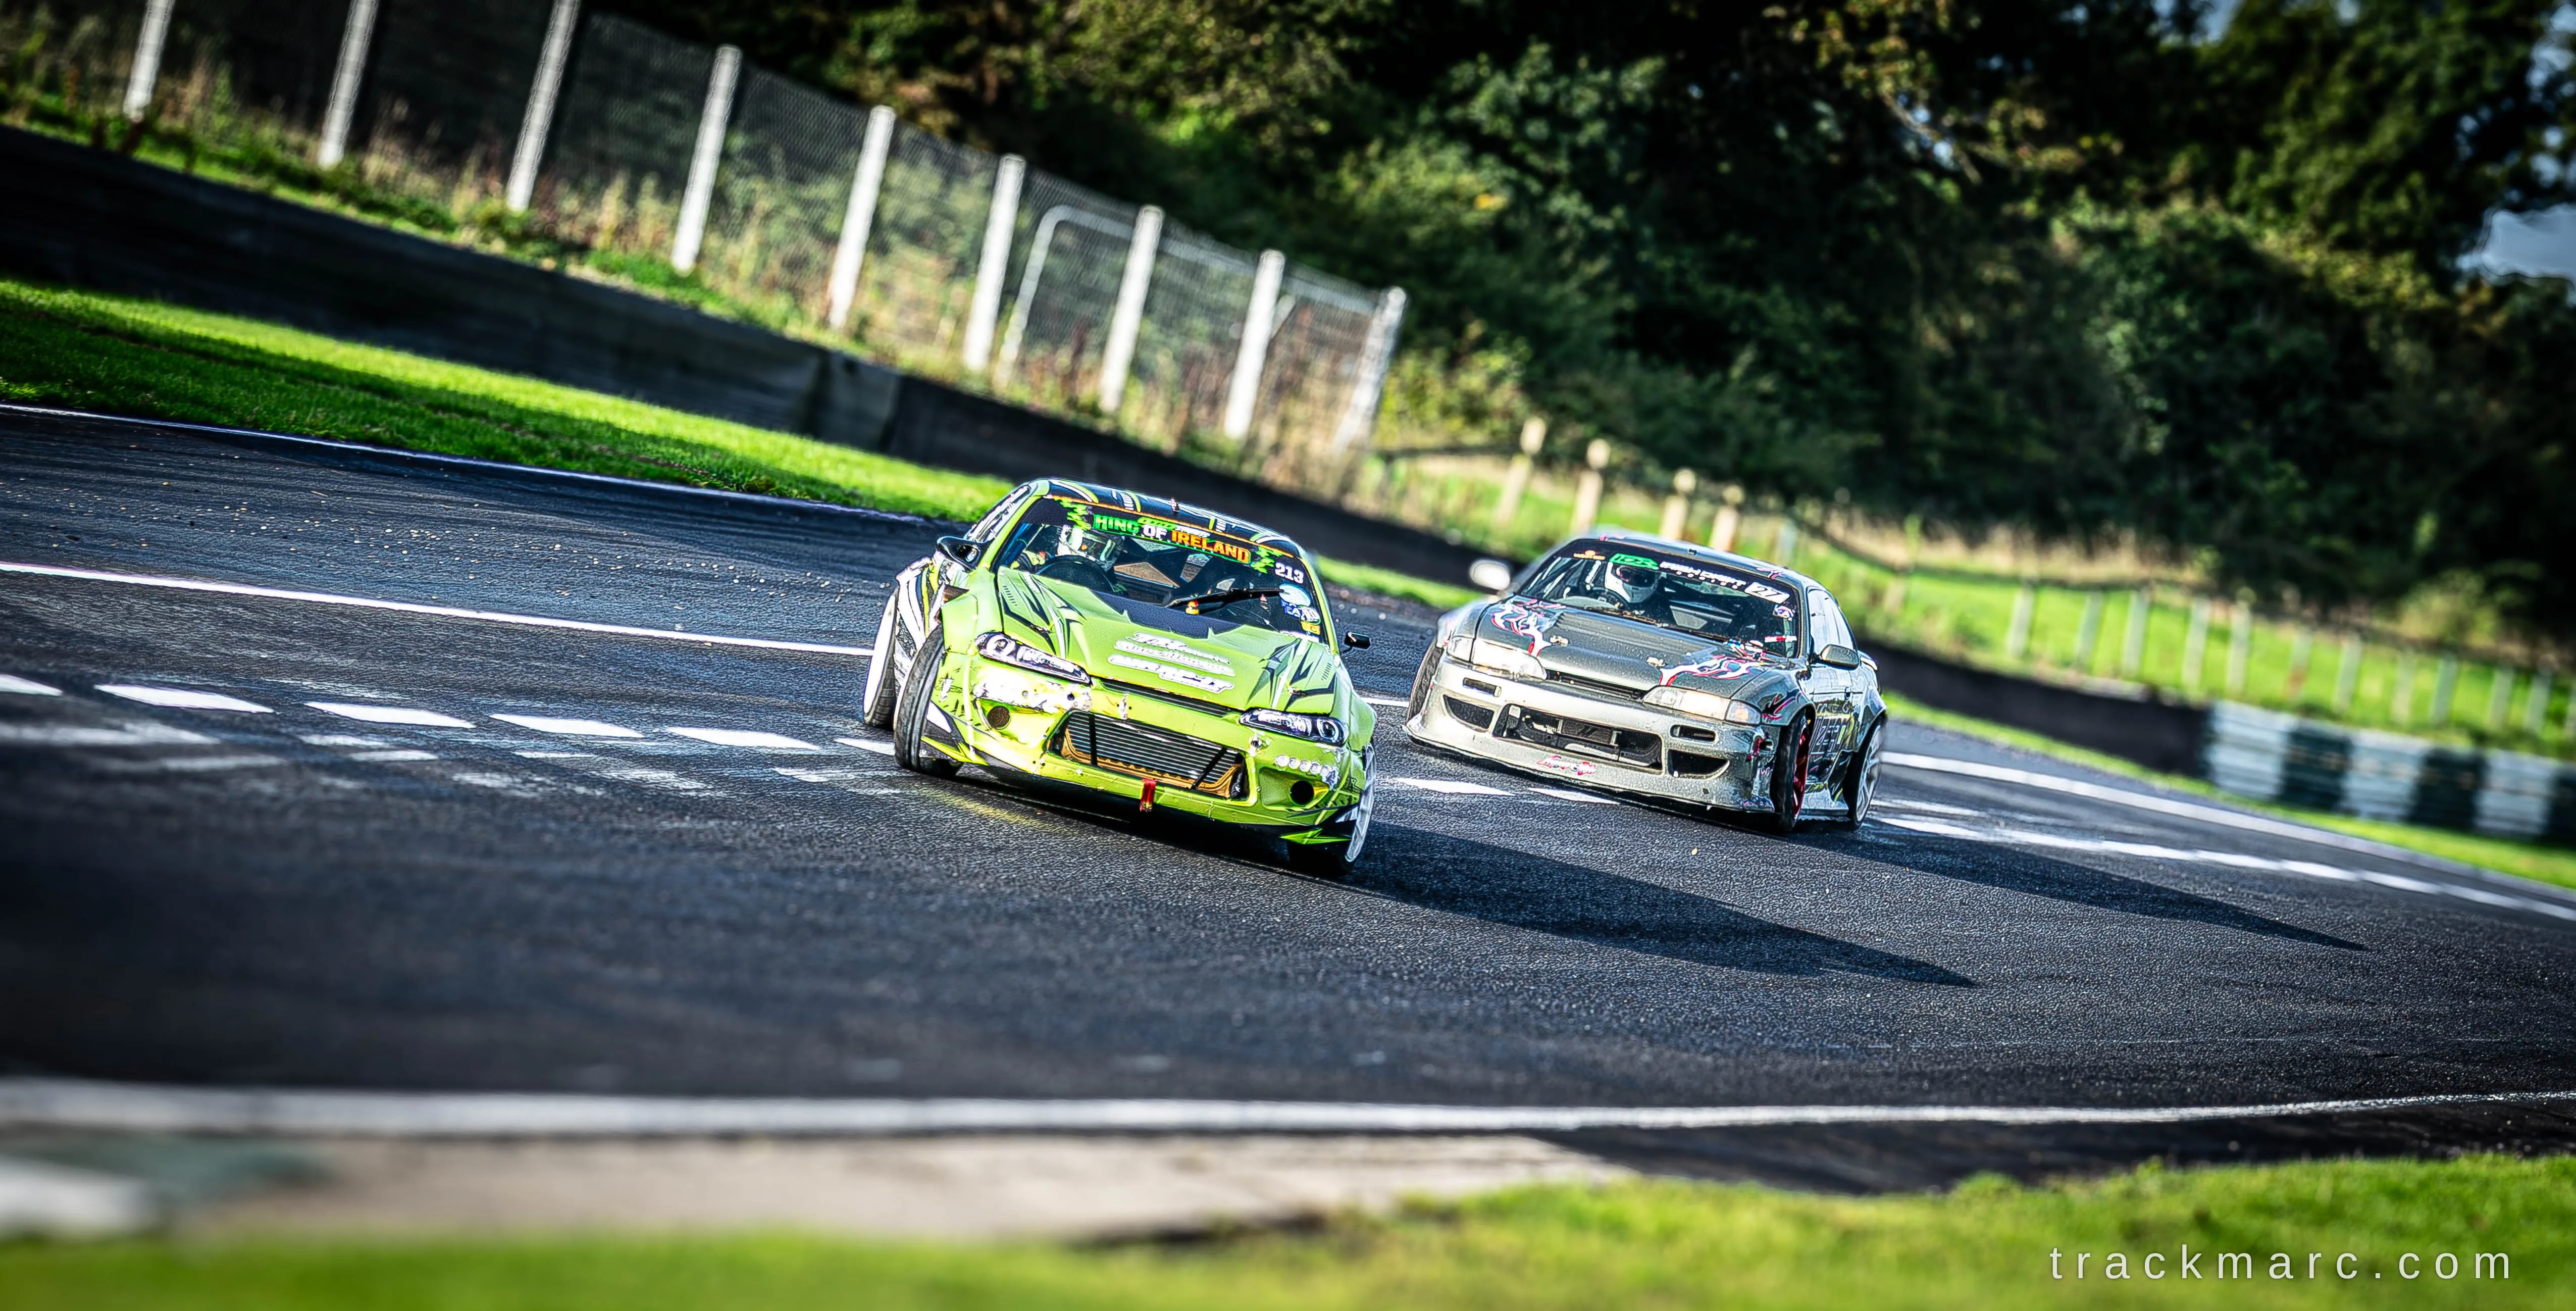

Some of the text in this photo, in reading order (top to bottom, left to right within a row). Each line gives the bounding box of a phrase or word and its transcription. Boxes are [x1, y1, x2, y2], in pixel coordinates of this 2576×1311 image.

[1143, 524, 1167, 539] OF
[1171, 530, 1250, 563] IRELAND
[1275, 562, 1304, 584] 213
